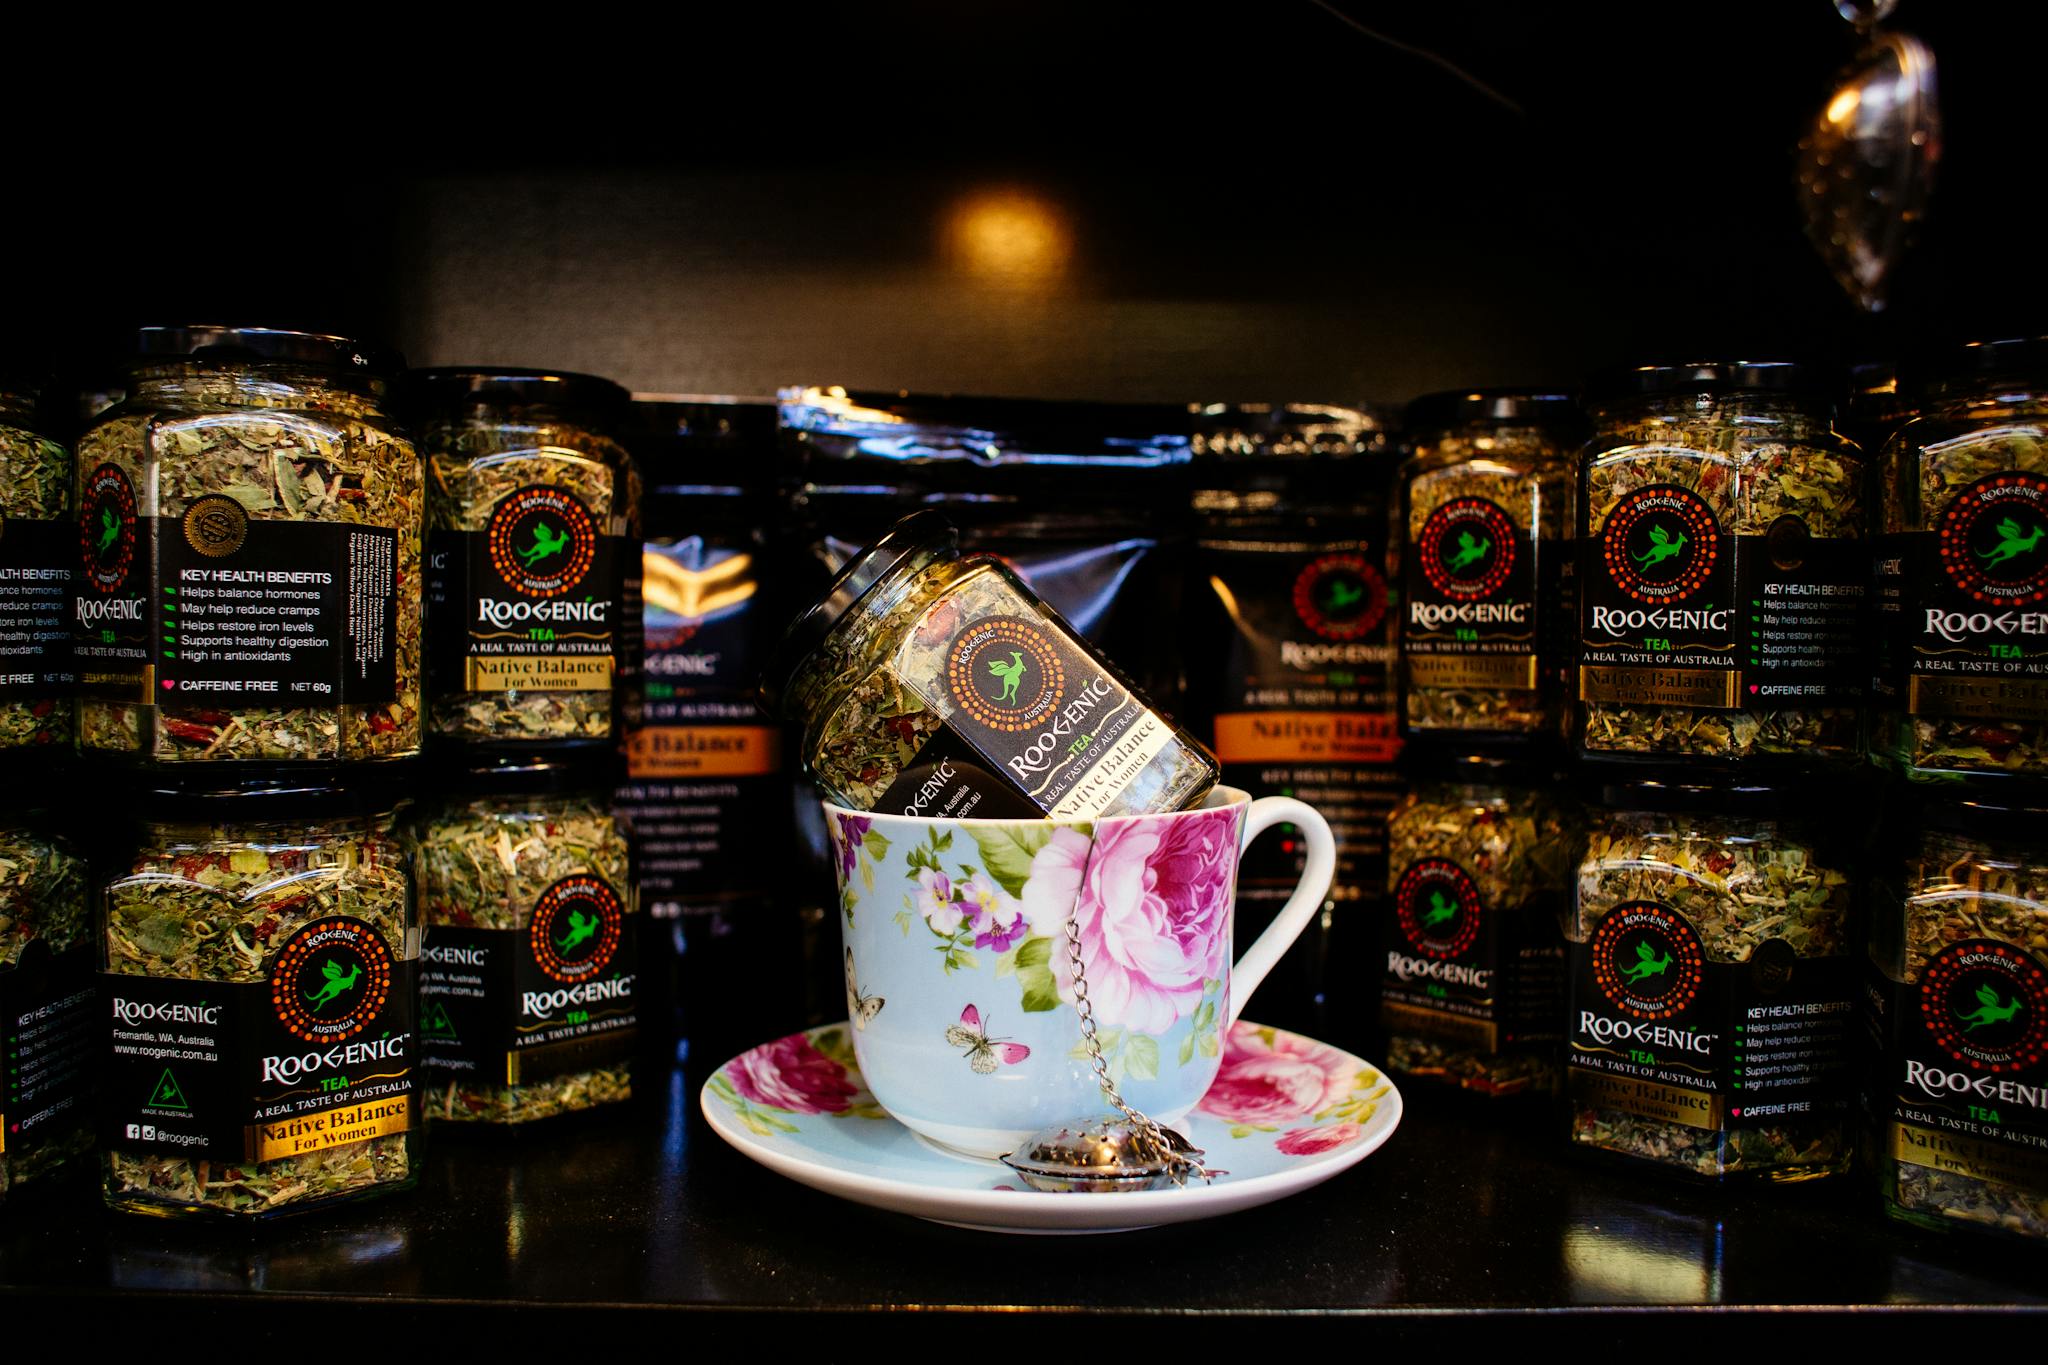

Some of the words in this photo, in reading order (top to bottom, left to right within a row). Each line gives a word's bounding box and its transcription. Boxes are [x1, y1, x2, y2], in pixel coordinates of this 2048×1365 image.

[1979, 486, 2043, 501] ROOGENIC
[1636, 497, 1687, 512] ROOGENIC
[384, 536, 392, 596] Ingredients
[22, 569, 71, 580] BENEFITS
[181, 569, 209, 581] KEY
[212, 571, 264, 582] HEALTH
[267, 572, 332, 584] BENEFITS
[181, 587, 215, 598] Helps
[218, 588, 263, 599] balance
[265, 589, 320, 599] hormones
[1638, 584, 1680, 596] AUSTRALIA
[1764, 584, 1784, 595] KEY
[1785, 584, 1820, 595] HEALTH
[1821, 585, 1864, 596] BENEFITS
[1981, 584, 2034, 597] AUSTRALIA
[181, 603, 206, 615] May
[208, 604, 233, 615] help
[236, 605, 275, 615] reduce
[278, 607, 320, 617] cramps
[1763, 600, 1786, 610] Helps
[1788, 600, 1818, 610] balance
[76, 597, 143, 629] ROOGENIC
[478, 598, 606, 629] ROOGENIC
[1411, 602, 1525, 630] ROOGENIC
[1763, 615, 1780, 626] May
[1781, 616, 1798, 626] help
[1800, 616, 1826, 625] reduce
[181, 620, 215, 632] Helps
[217, 622, 256, 631] restore
[259, 622, 279, 631] iron
[282, 622, 314, 632] levels
[1592, 606, 1728, 637] ROOGENIC
[102, 630, 116, 643] TEA
[181, 635, 232, 647] Supports
[235, 636, 276, 648] healthy
[279, 637, 329, 649] digestion
[529, 628, 555, 641] TEA
[1456, 629, 1478, 641] TEA
[470, 643, 478, 652] A
[482, 643, 503, 652] REAL
[507, 643, 537, 652] TASTE
[540, 643, 555, 652] OF
[557, 643, 611, 652] AUSTRALIA
[958, 629, 996, 665] ROOGENIC
[1644, 638, 1671, 650] TEA
[1990, 645, 2022, 658] TEA
[181, 651, 208, 662] High
[212, 651, 221, 660] in
[224, 651, 291, 661] antioxidants
[1583, 652, 1591, 661] A
[1593, 652, 1617, 662] REAL
[1620, 653, 1653, 663] TASTE
[1656, 654, 1671, 663] OF
[1673, 655, 1734, 666] AUSTRALIA
[476, 660, 532, 674] Native
[537, 659, 605, 673] Balance
[1914, 660, 1922, 669] A
[1925, 660, 1955, 670] REAL
[1959, 661, 1999, 672] TASTE
[2004, 663, 2022, 673] OF
[9, 674, 34, 683] FREE
[504, 676, 525, 687] For
[529, 677, 577, 687] Women
[180, 680, 242, 691] CAFFEINE
[245, 681, 278, 691] FREE
[291, 683, 311, 691] NET
[313, 683, 332, 693] 60g
[1761, 686, 1802, 695] CAFFEINE
[1804, 686, 1826, 695] FREE
[1024, 691, 1054, 721] AUSTRALIA
[1008, 673, 1113, 781] ROOGENIC
[1068, 734, 1093, 757] TEA
[1039, 801, 1048, 811] A
[1045, 782, 1067, 804] REAL
[1064, 756, 1091, 783] TASTE
[1089, 744, 1101, 757] OF
[1102, 703, 1141, 746] AUSTRALIA
[1058, 775, 1105, 818] Native
[1101, 720, 1156, 776] Balance
[904, 760, 956, 817] OGENIC
[1090, 793, 1111, 811] For
[1109, 752, 1149, 790] Women
[944, 784, 970, 812] Australia
[1624, 914, 1672, 931] ROOGENIC
[306, 929, 359, 948] ROOGENIC
[1960, 953, 2020, 973] ROOGENIC
[522, 978, 631, 1019] ROOGENIC
[1624, 997, 1665, 1011] AUSTRALIA
[113, 998, 217, 1027] ROOGENIC
[566, 1011, 589, 1024] TEA
[1748, 1007, 1768, 1019] KEY
[1769, 1005, 1805, 1017] HEALTH
[312, 1019, 355, 1034] AUSTRALIA
[1579, 1010, 1711, 1055] ROOGENIC
[114, 1029, 157, 1043] Fremantle,
[159, 1033, 176, 1044] WA,
[178, 1034, 215, 1047] Australia
[515, 1037, 523, 1046] A
[114, 1045, 218, 1061] www.roogenic.com.au
[1629, 1050, 1656, 1065] TEA
[1961, 1046, 2012, 1062] AUSTRALIA
[262, 1036, 405, 1086] ROOGENIC
[1571, 1054, 1579, 1063] A
[1580, 1055, 1604, 1068] REAL
[1606, 1060, 1638, 1075] TASTE
[1640, 1066, 1656, 1077] OF
[1658, 1070, 1717, 1089] AUSTRALIA
[1745, 1066, 1780, 1077] Supports
[1782, 1063, 1810, 1074] healthy
[321, 1075, 349, 1093] TEA
[1744, 1080, 1764, 1091] High
[1904, 1059, 2048, 1110] ROOGENI
[254, 1109, 263, 1120] A
[266, 1104, 294, 1118] REAL
[297, 1096, 332, 1112] TASTE
[335, 1092, 350, 1104] OF
[352, 1080, 412, 1100] AUSTRALIA
[1636, 1083, 1709, 1111] Balance
[1744, 1104, 1786, 1117] CAFFEINE
[1787, 1101, 1811, 1112] FREE
[1968, 1105, 2001, 1123] TEA
[263, 1115, 326, 1144] Native
[331, 1100, 406, 1129] Balance
[1895, 1107, 1903, 1118] A
[1905, 1109, 1935, 1124] REAL
[1938, 1116, 1978, 1133] TASTE
[1982, 1126, 2000, 1137] OF
[2003, 1130, 2048, 1149] AUSTR
[157, 1130, 209, 1146] @roogenic
[294, 1136, 319, 1152] For
[324, 1126, 377, 1145] Women
